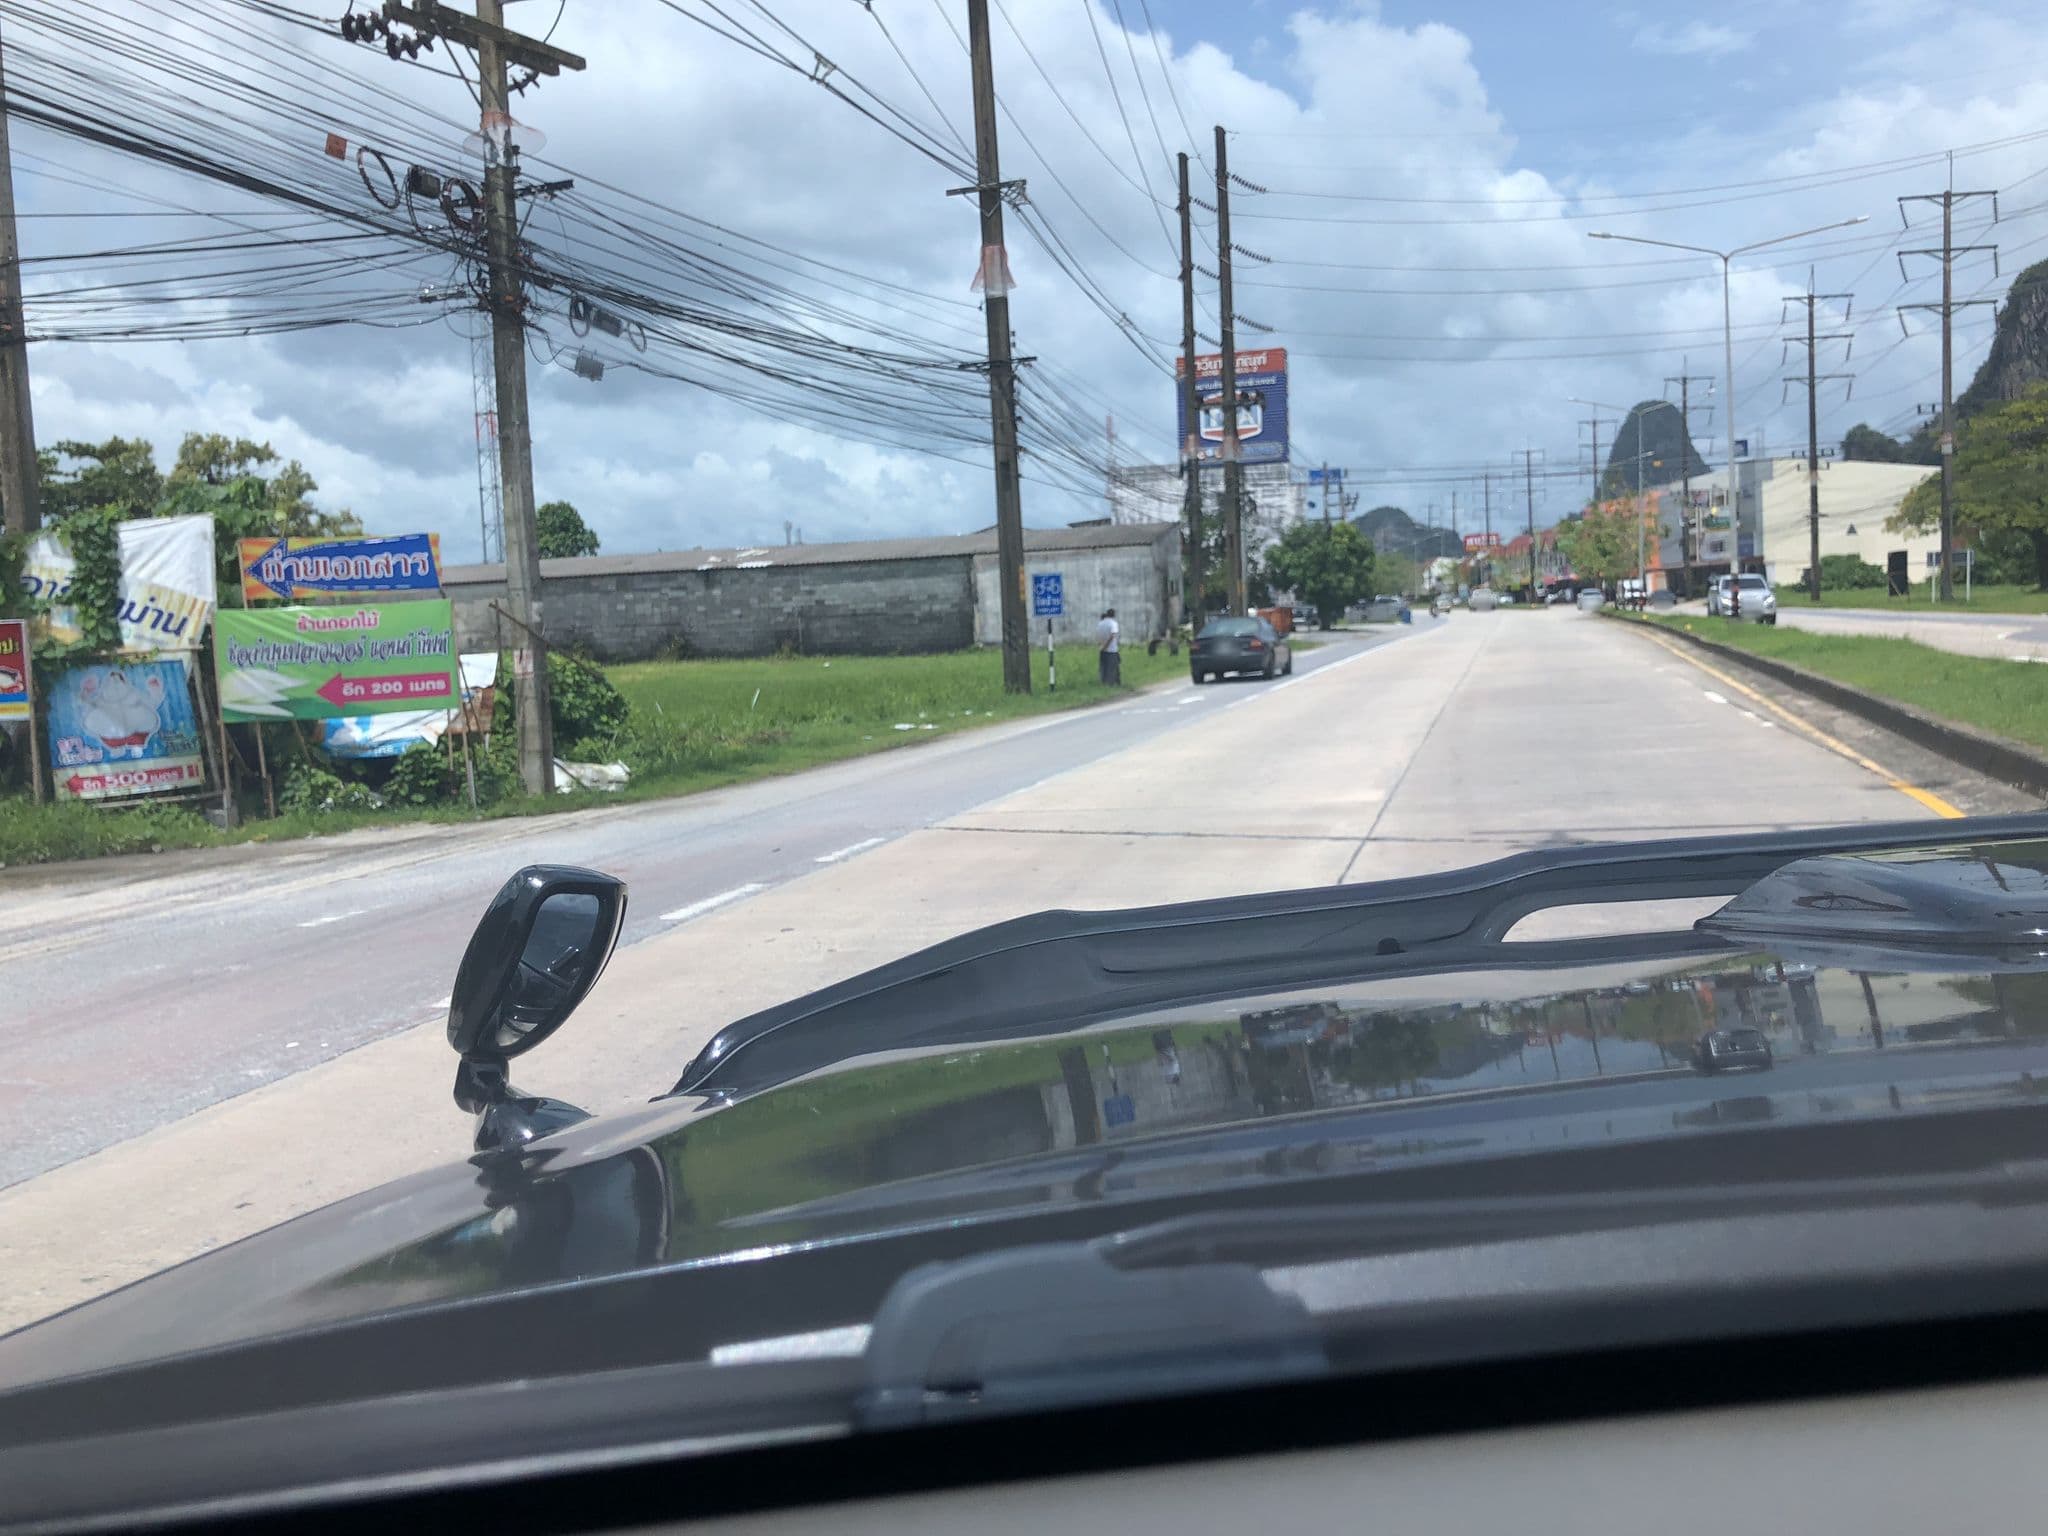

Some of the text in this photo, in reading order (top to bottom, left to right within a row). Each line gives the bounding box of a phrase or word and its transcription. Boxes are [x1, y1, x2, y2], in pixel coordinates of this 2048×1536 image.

[261, 548, 430, 583] ถ่ายเอกสาร
[342, 681, 365, 697] อีก
[371, 681, 403, 696] 200
[104, 772, 148, 788] 500
